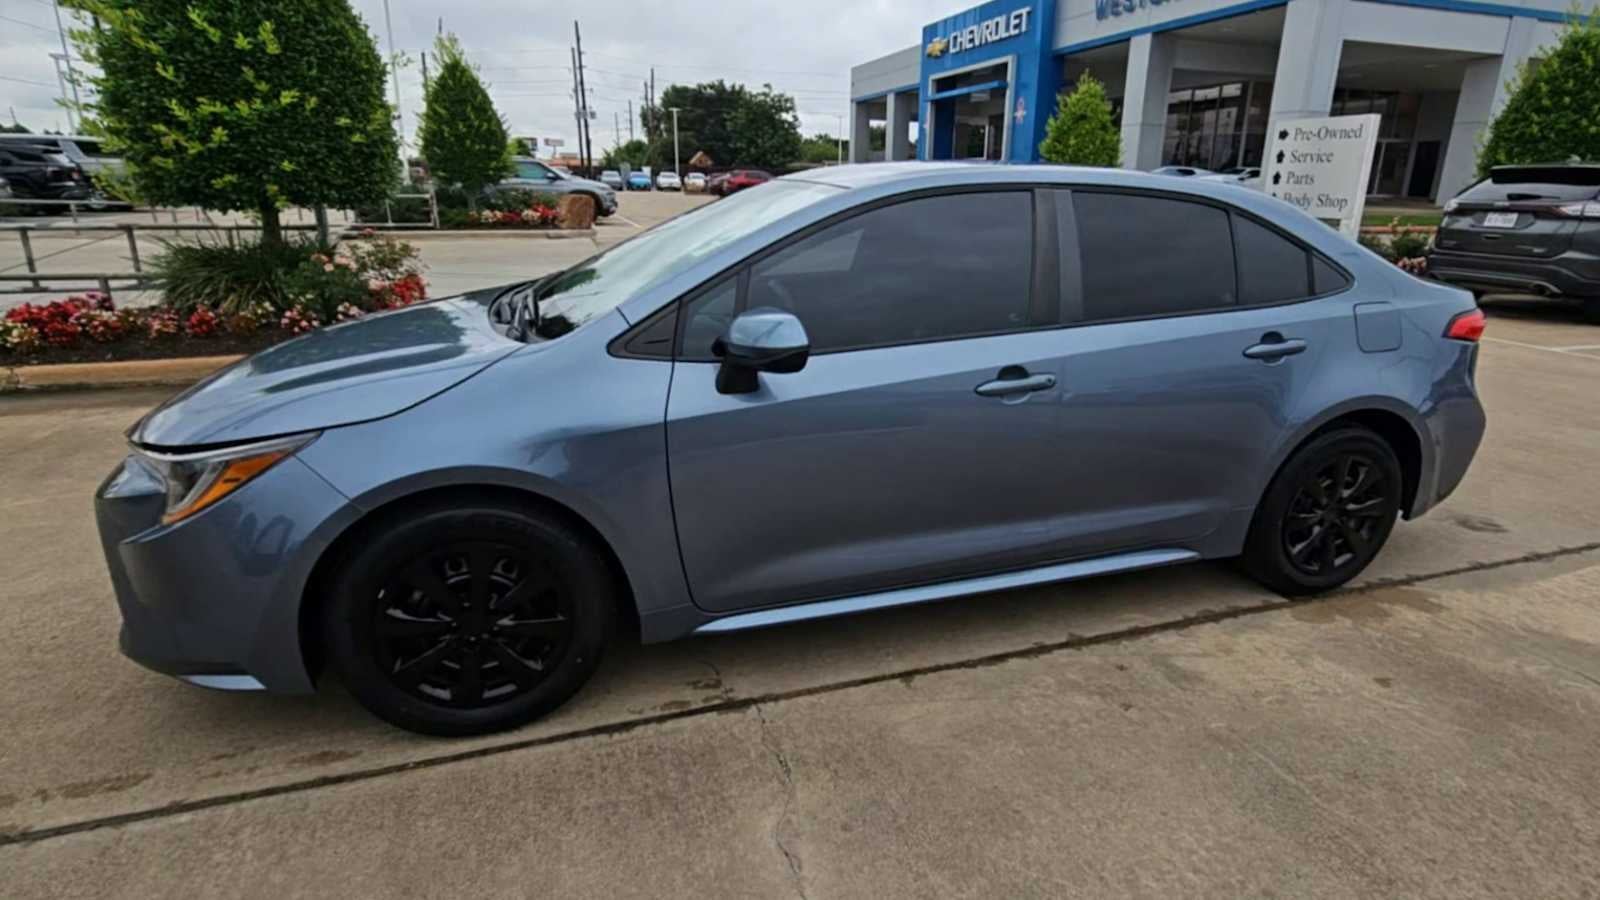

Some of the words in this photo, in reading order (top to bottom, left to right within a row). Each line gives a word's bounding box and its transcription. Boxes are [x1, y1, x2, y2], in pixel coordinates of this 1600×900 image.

[949, 6, 1032, 54] CHEVROLET
[1294, 123, 1363, 141] Pre-Owned
[1290, 148, 1334, 163] Service
[1285, 171, 1315, 184] Parts
[1315, 193, 1348, 211] Shop
